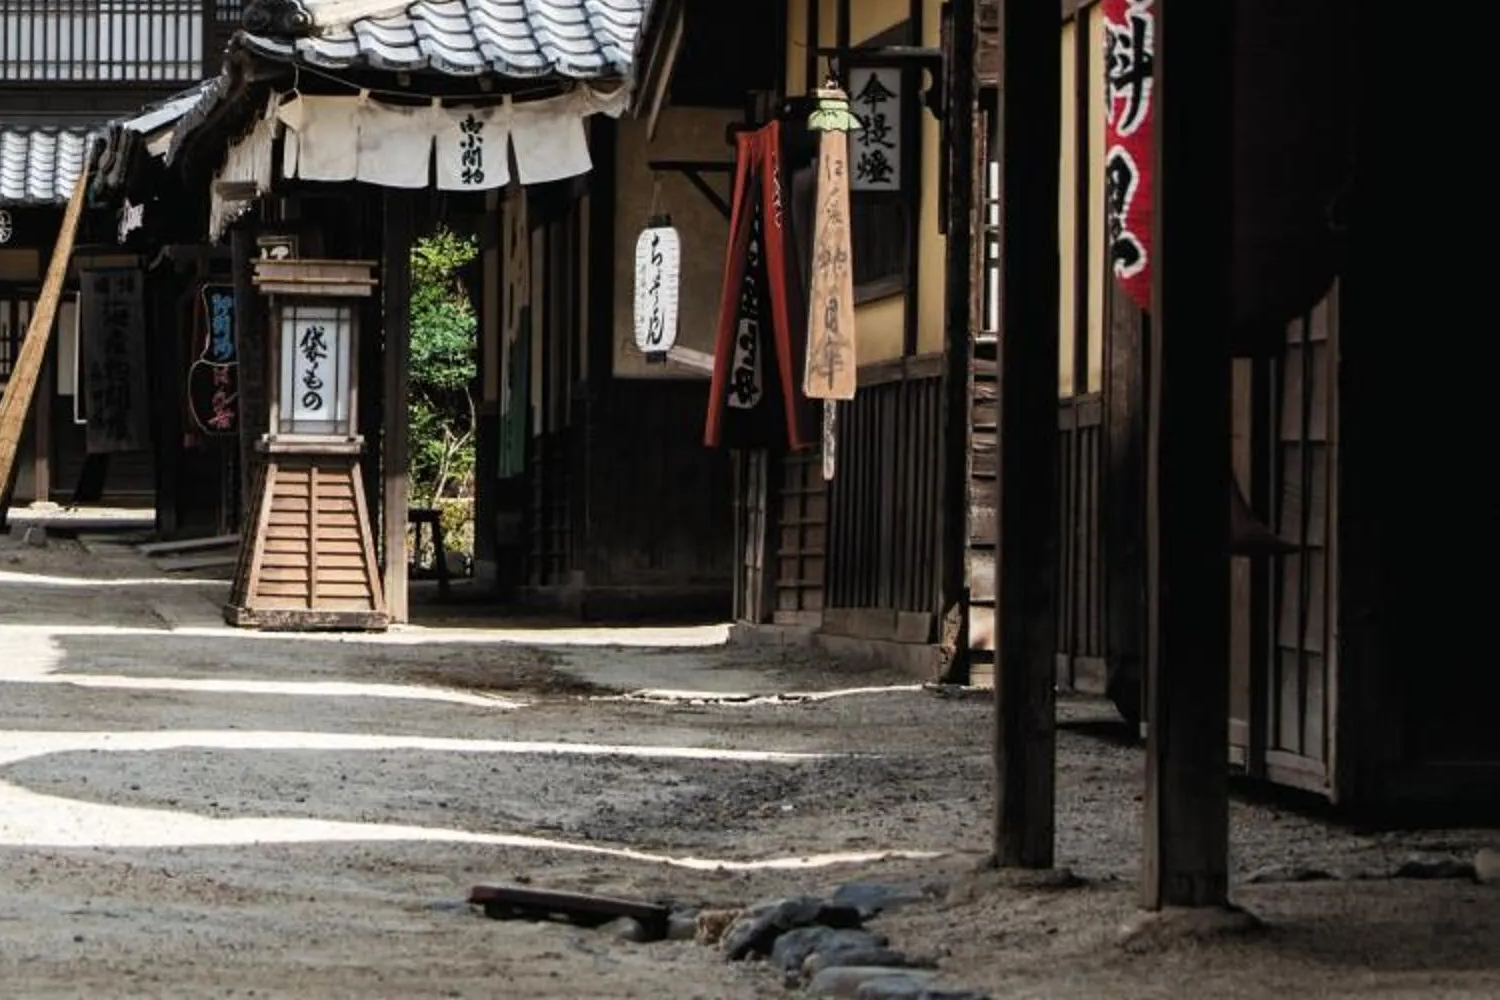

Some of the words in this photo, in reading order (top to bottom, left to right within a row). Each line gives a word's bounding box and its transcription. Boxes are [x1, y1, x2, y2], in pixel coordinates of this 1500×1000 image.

[460, 113, 484, 184] 御小間物
[300, 325, 327, 411] 袋もの
